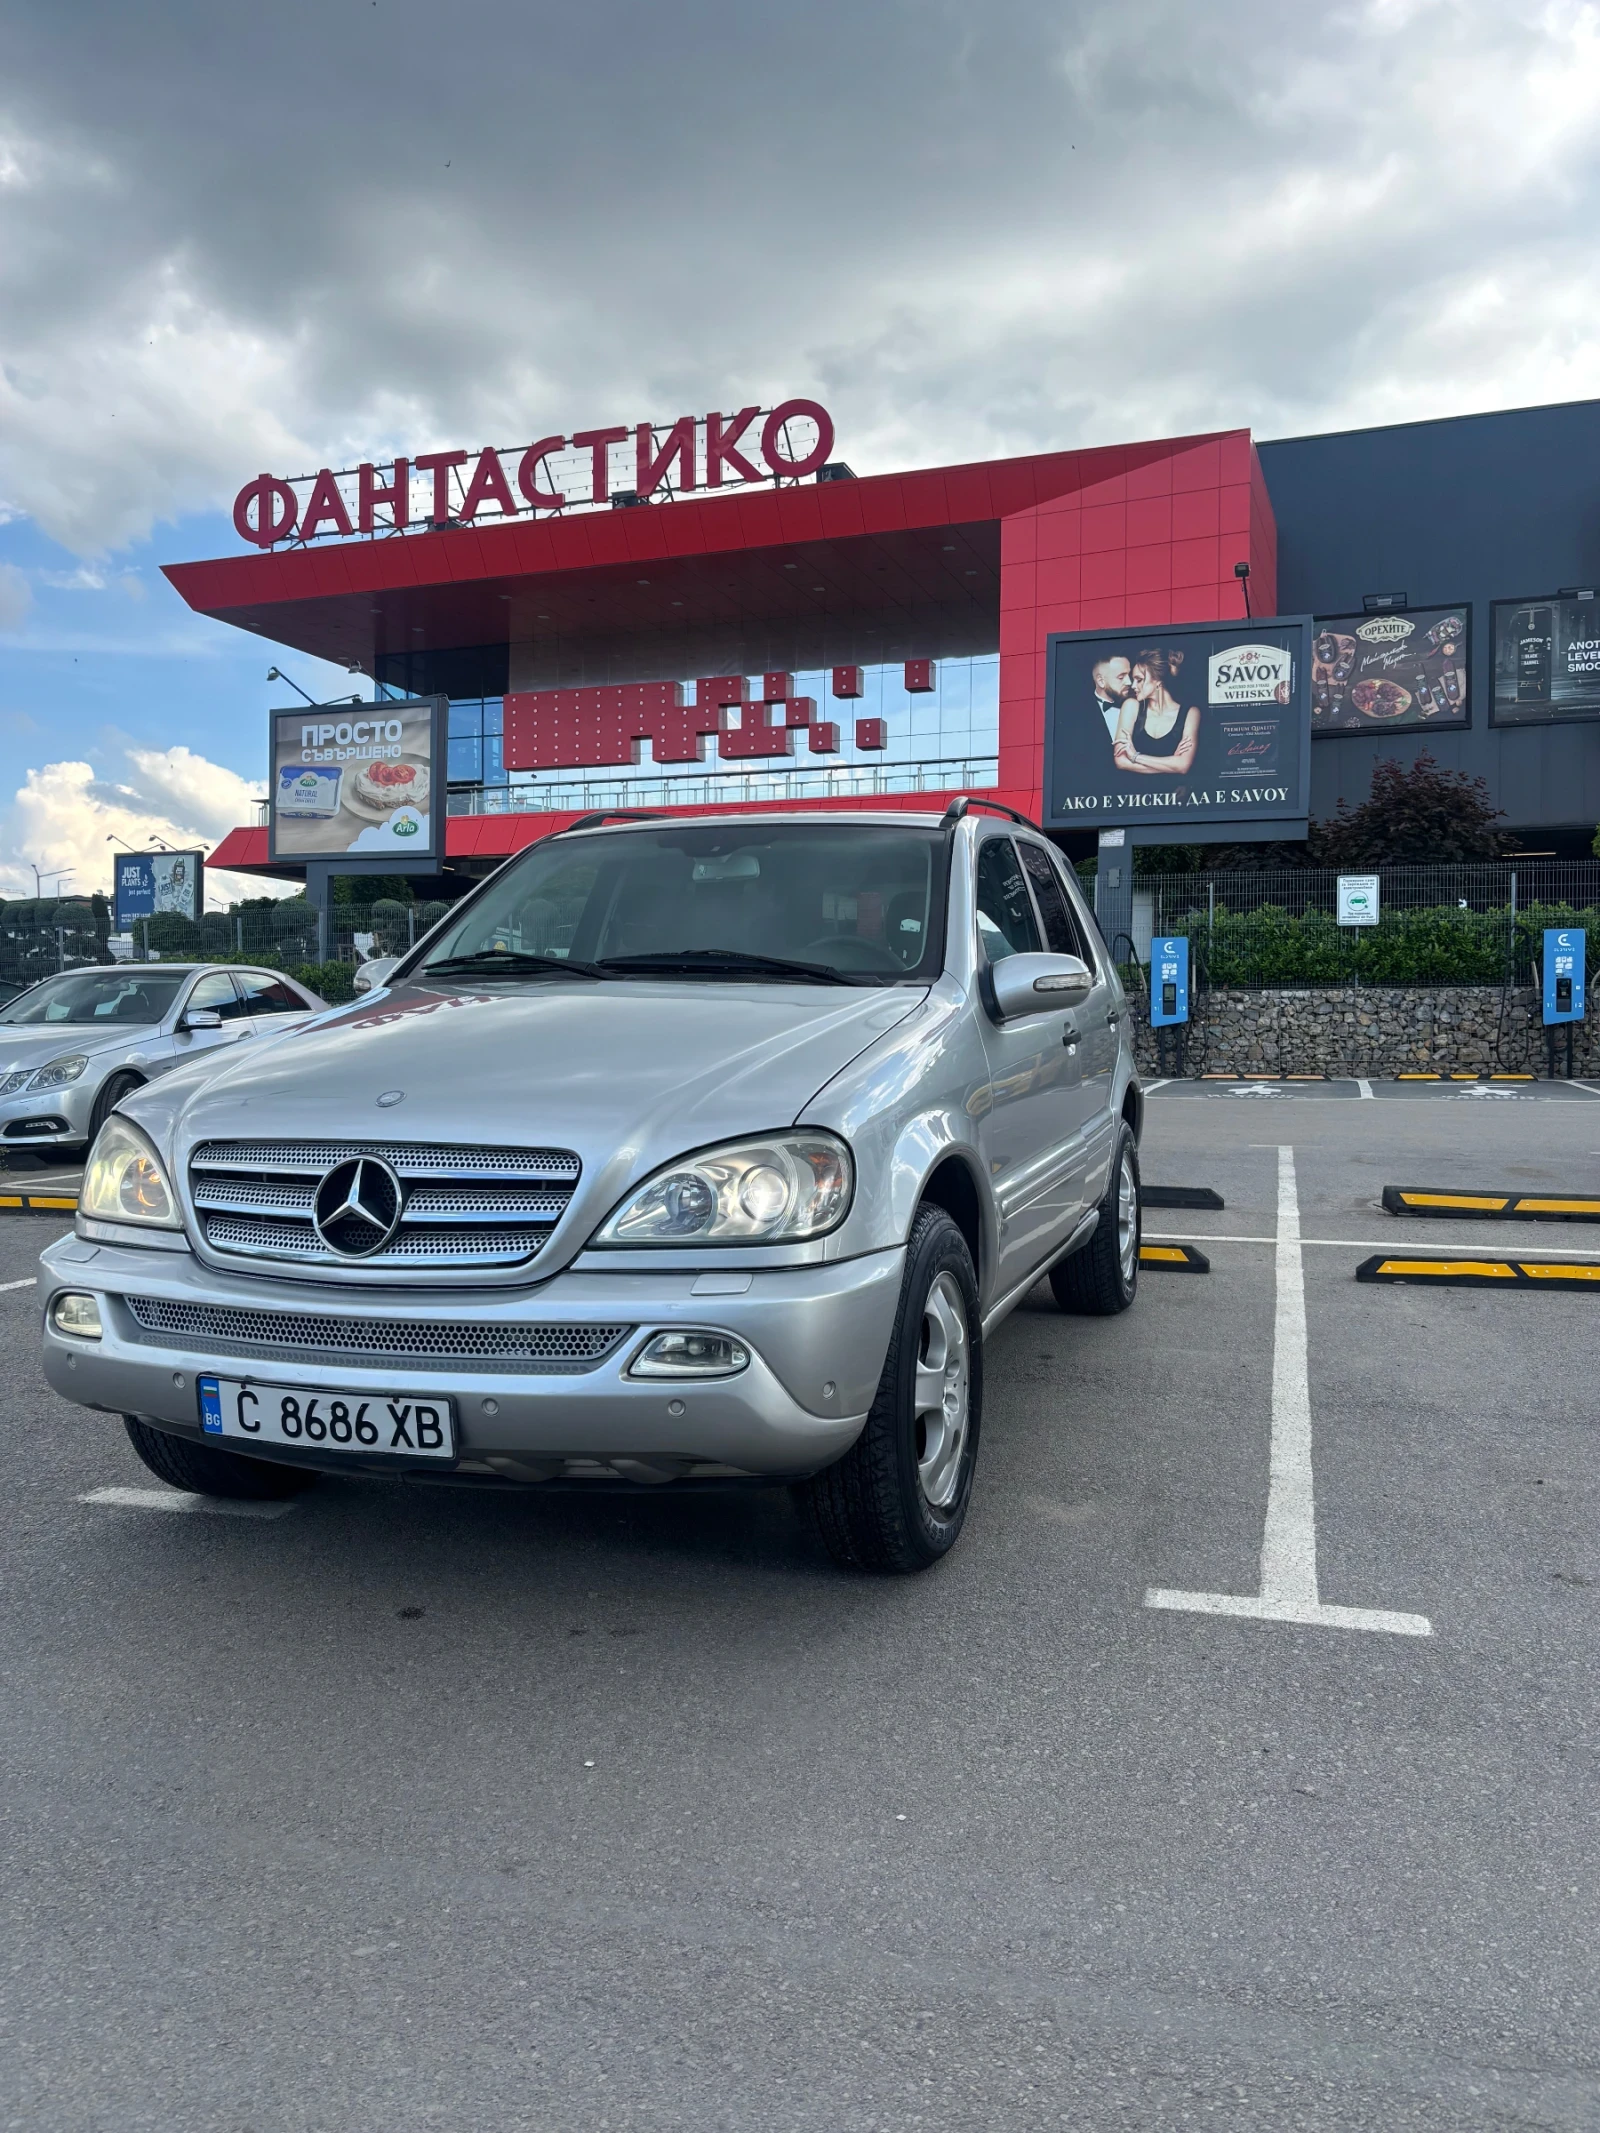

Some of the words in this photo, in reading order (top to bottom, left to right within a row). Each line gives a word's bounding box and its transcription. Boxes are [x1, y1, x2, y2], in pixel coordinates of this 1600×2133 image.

[233, 399, 835, 549] ФАНТАСТИКО
[1364, 624, 1407, 636] ОРЕХИТЕ
[1520, 637, 1544, 645] JAMESON
[1215, 664, 1283, 688] SAVOY
[1224, 689, 1273, 699] WHISKY
[301, 719, 403, 747] ПРОСТО
[301, 744, 402, 763] СЪВЪРШЕНО
[301, 779, 316, 787] Arla
[294, 789, 318, 798] NATURAL
[1062, 795, 1098, 810] АКО
[1103, 795, 1113, 808] Е
[1117, 792, 1182, 807] УИСКИ,
[1186, 791, 1211, 806] ДА
[1215, 790, 1226, 804] Е
[1230, 787, 1289, 803] SAVOY
[395, 820, 416, 833] Arla
[121, 866, 141, 879] JUST
[121, 878, 141, 887] PLANTS
[205, 1412, 221, 1427] BG
[280, 1396, 379, 1446] 8686
